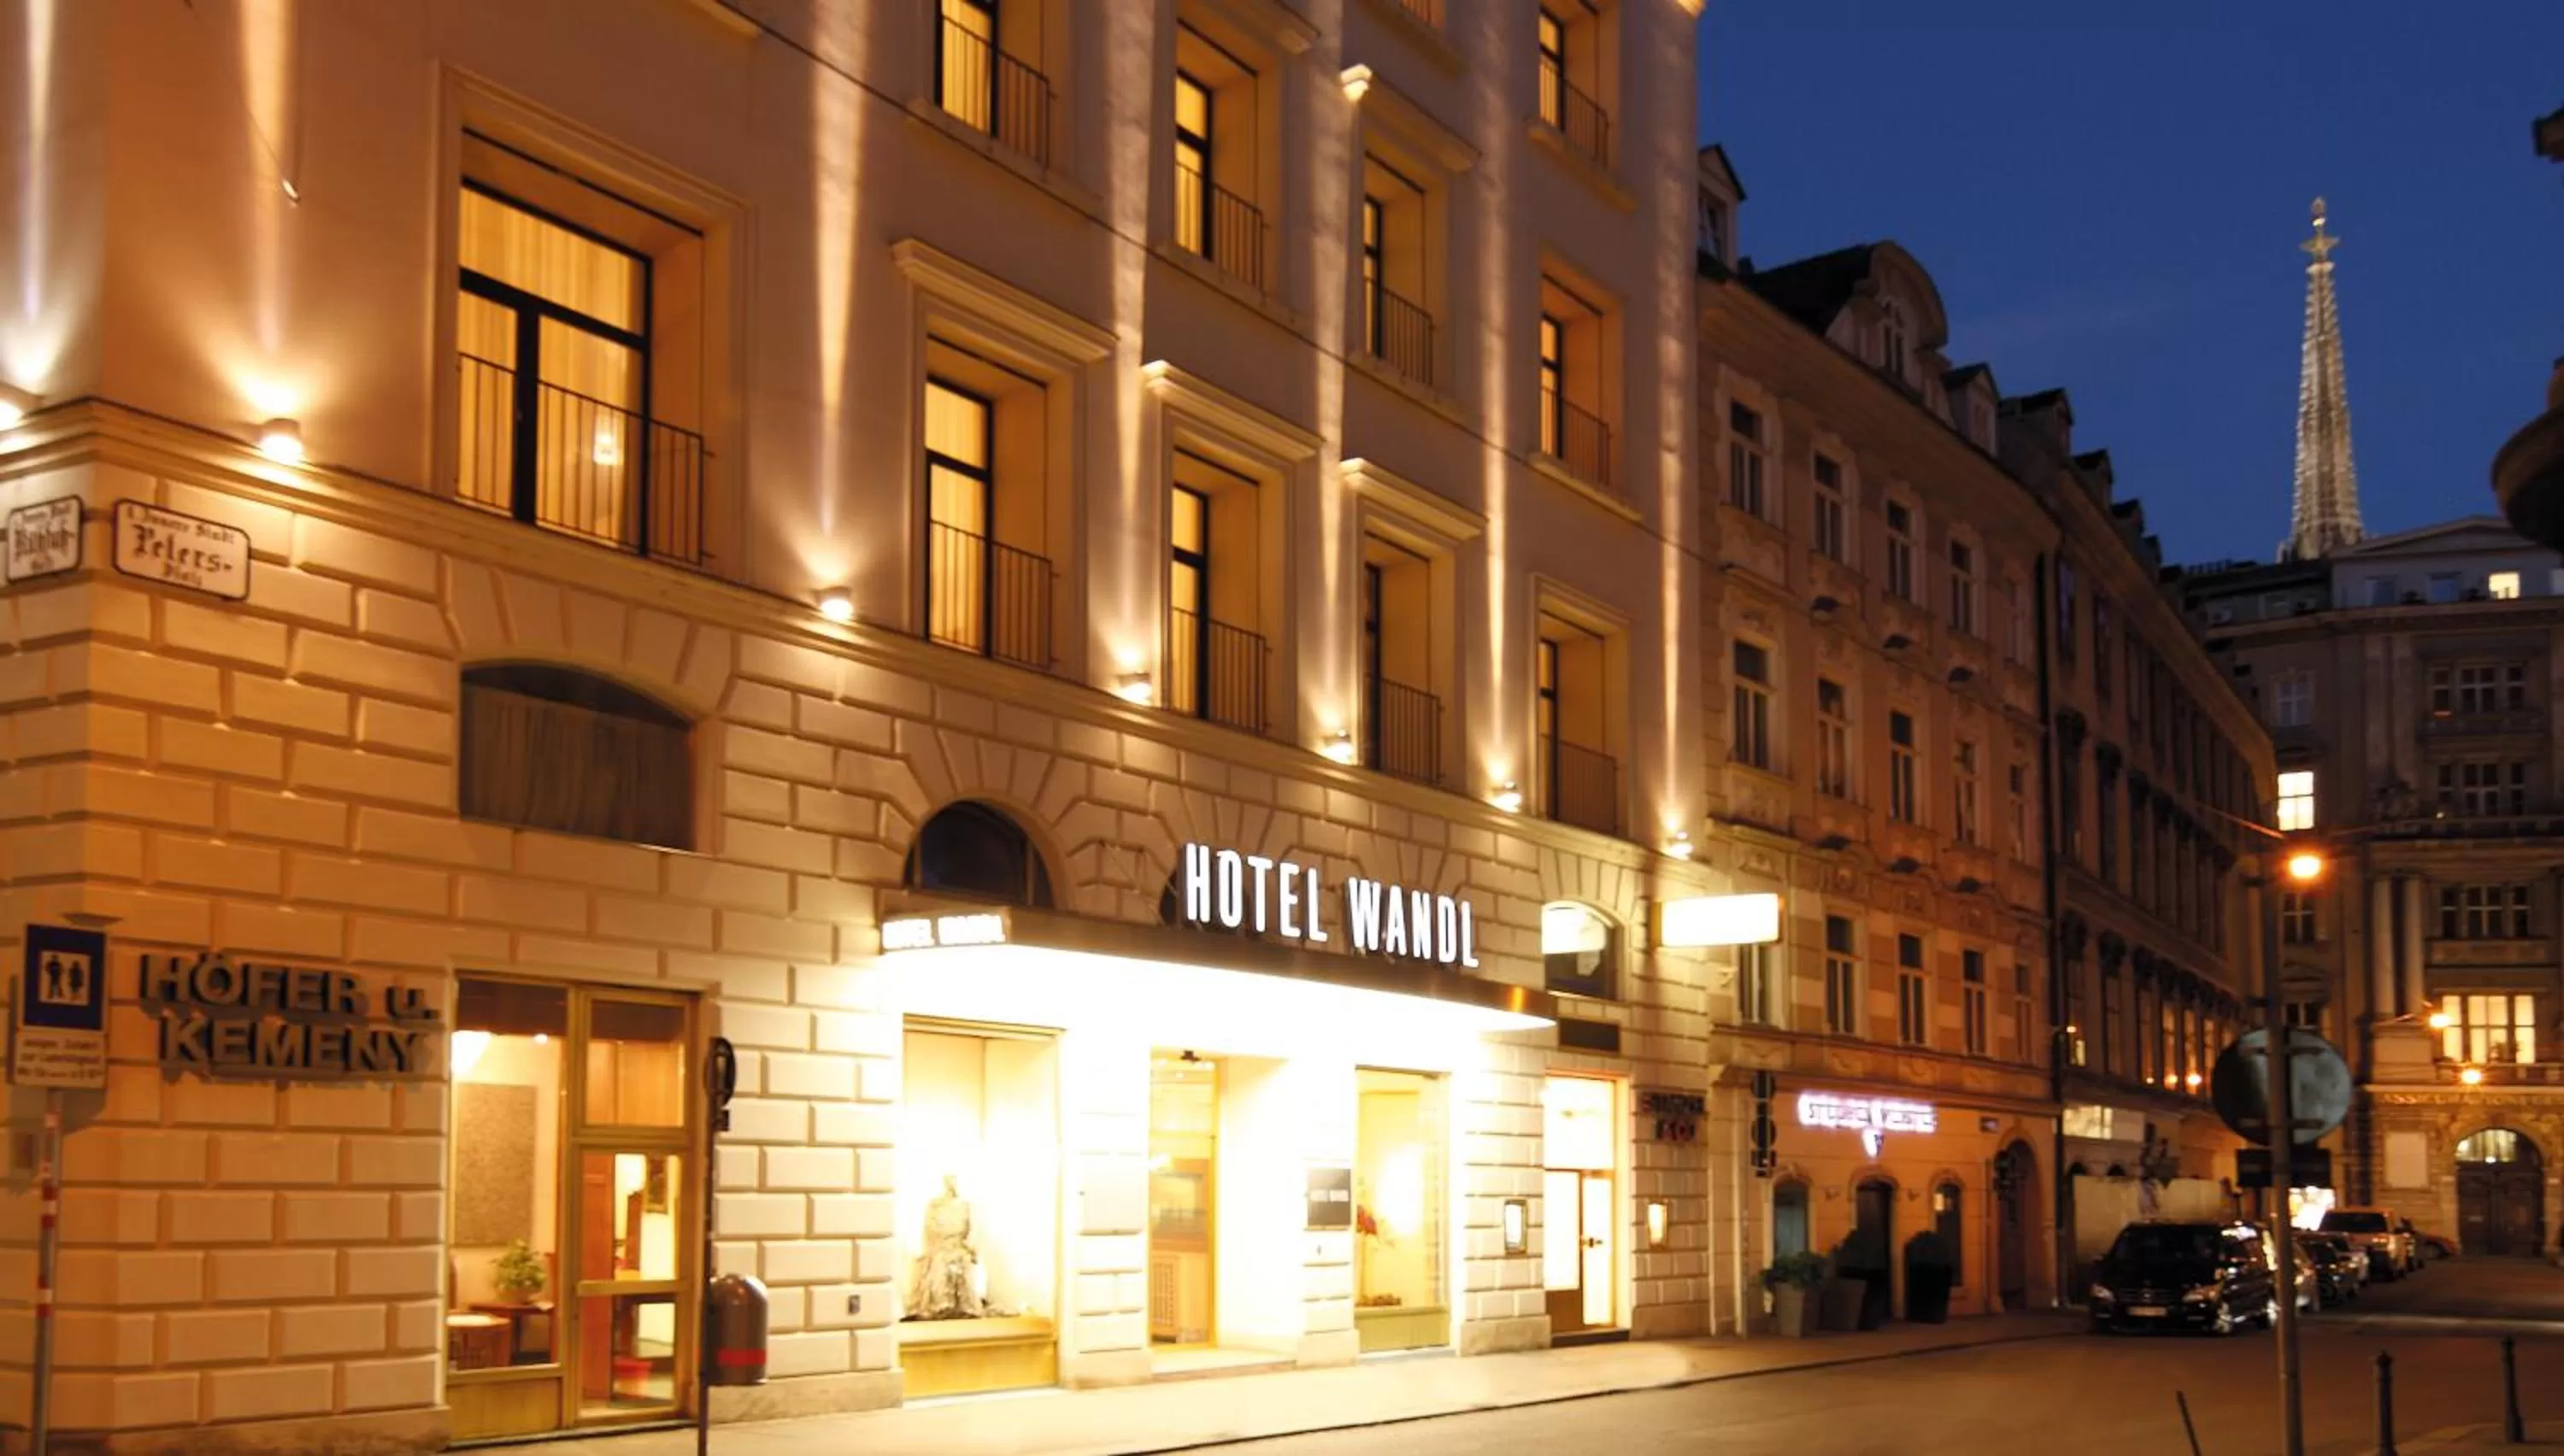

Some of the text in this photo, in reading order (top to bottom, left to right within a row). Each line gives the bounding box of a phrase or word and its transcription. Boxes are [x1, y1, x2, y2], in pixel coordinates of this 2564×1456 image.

[1185, 841, 1480, 968] HOTEL WANDL
[139, 952, 370, 1015] HÖFER
[157, 1012, 426, 1073] KEMENY
